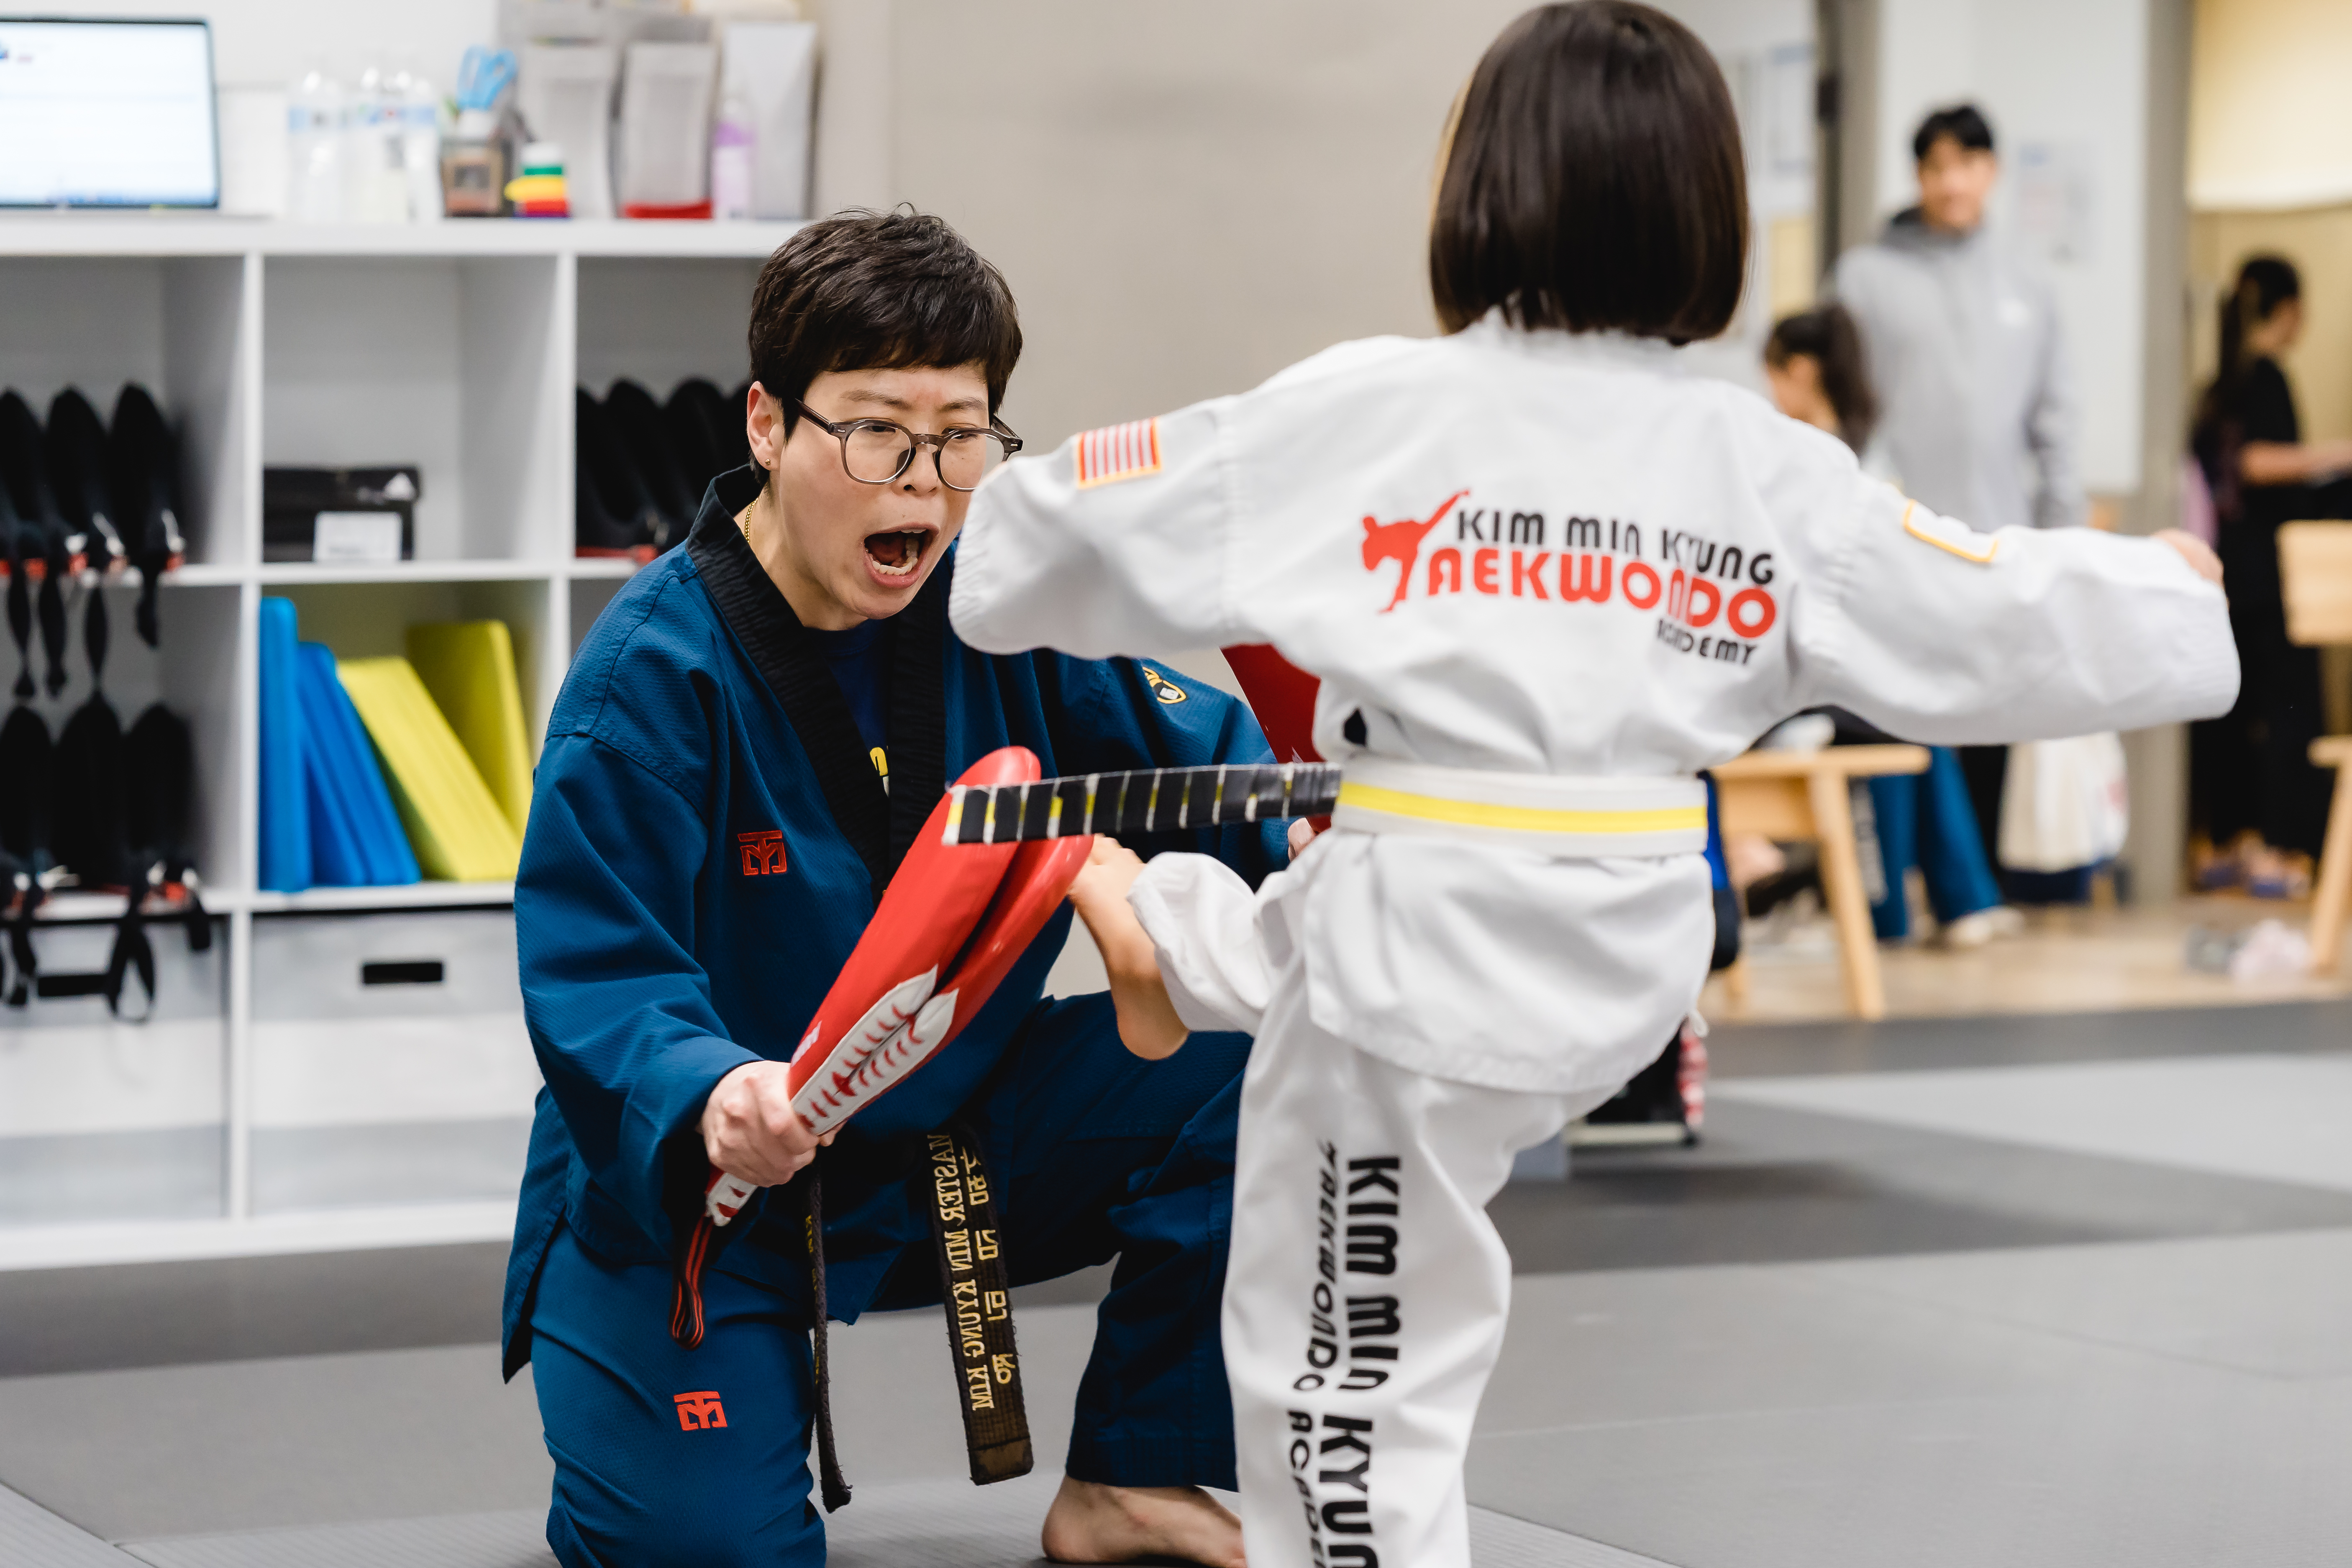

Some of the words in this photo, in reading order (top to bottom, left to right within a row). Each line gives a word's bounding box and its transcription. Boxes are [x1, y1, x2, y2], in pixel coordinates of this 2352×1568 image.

[1458, 510, 1545, 546] KIM
[1566, 516, 1640, 556] MIN
[1661, 529, 1774, 585] KUNG
[1657, 618, 1758, 665] DEMY
[1345, 1155, 1401, 1276] KIM
[1337, 1293, 1401, 1391] MIN
